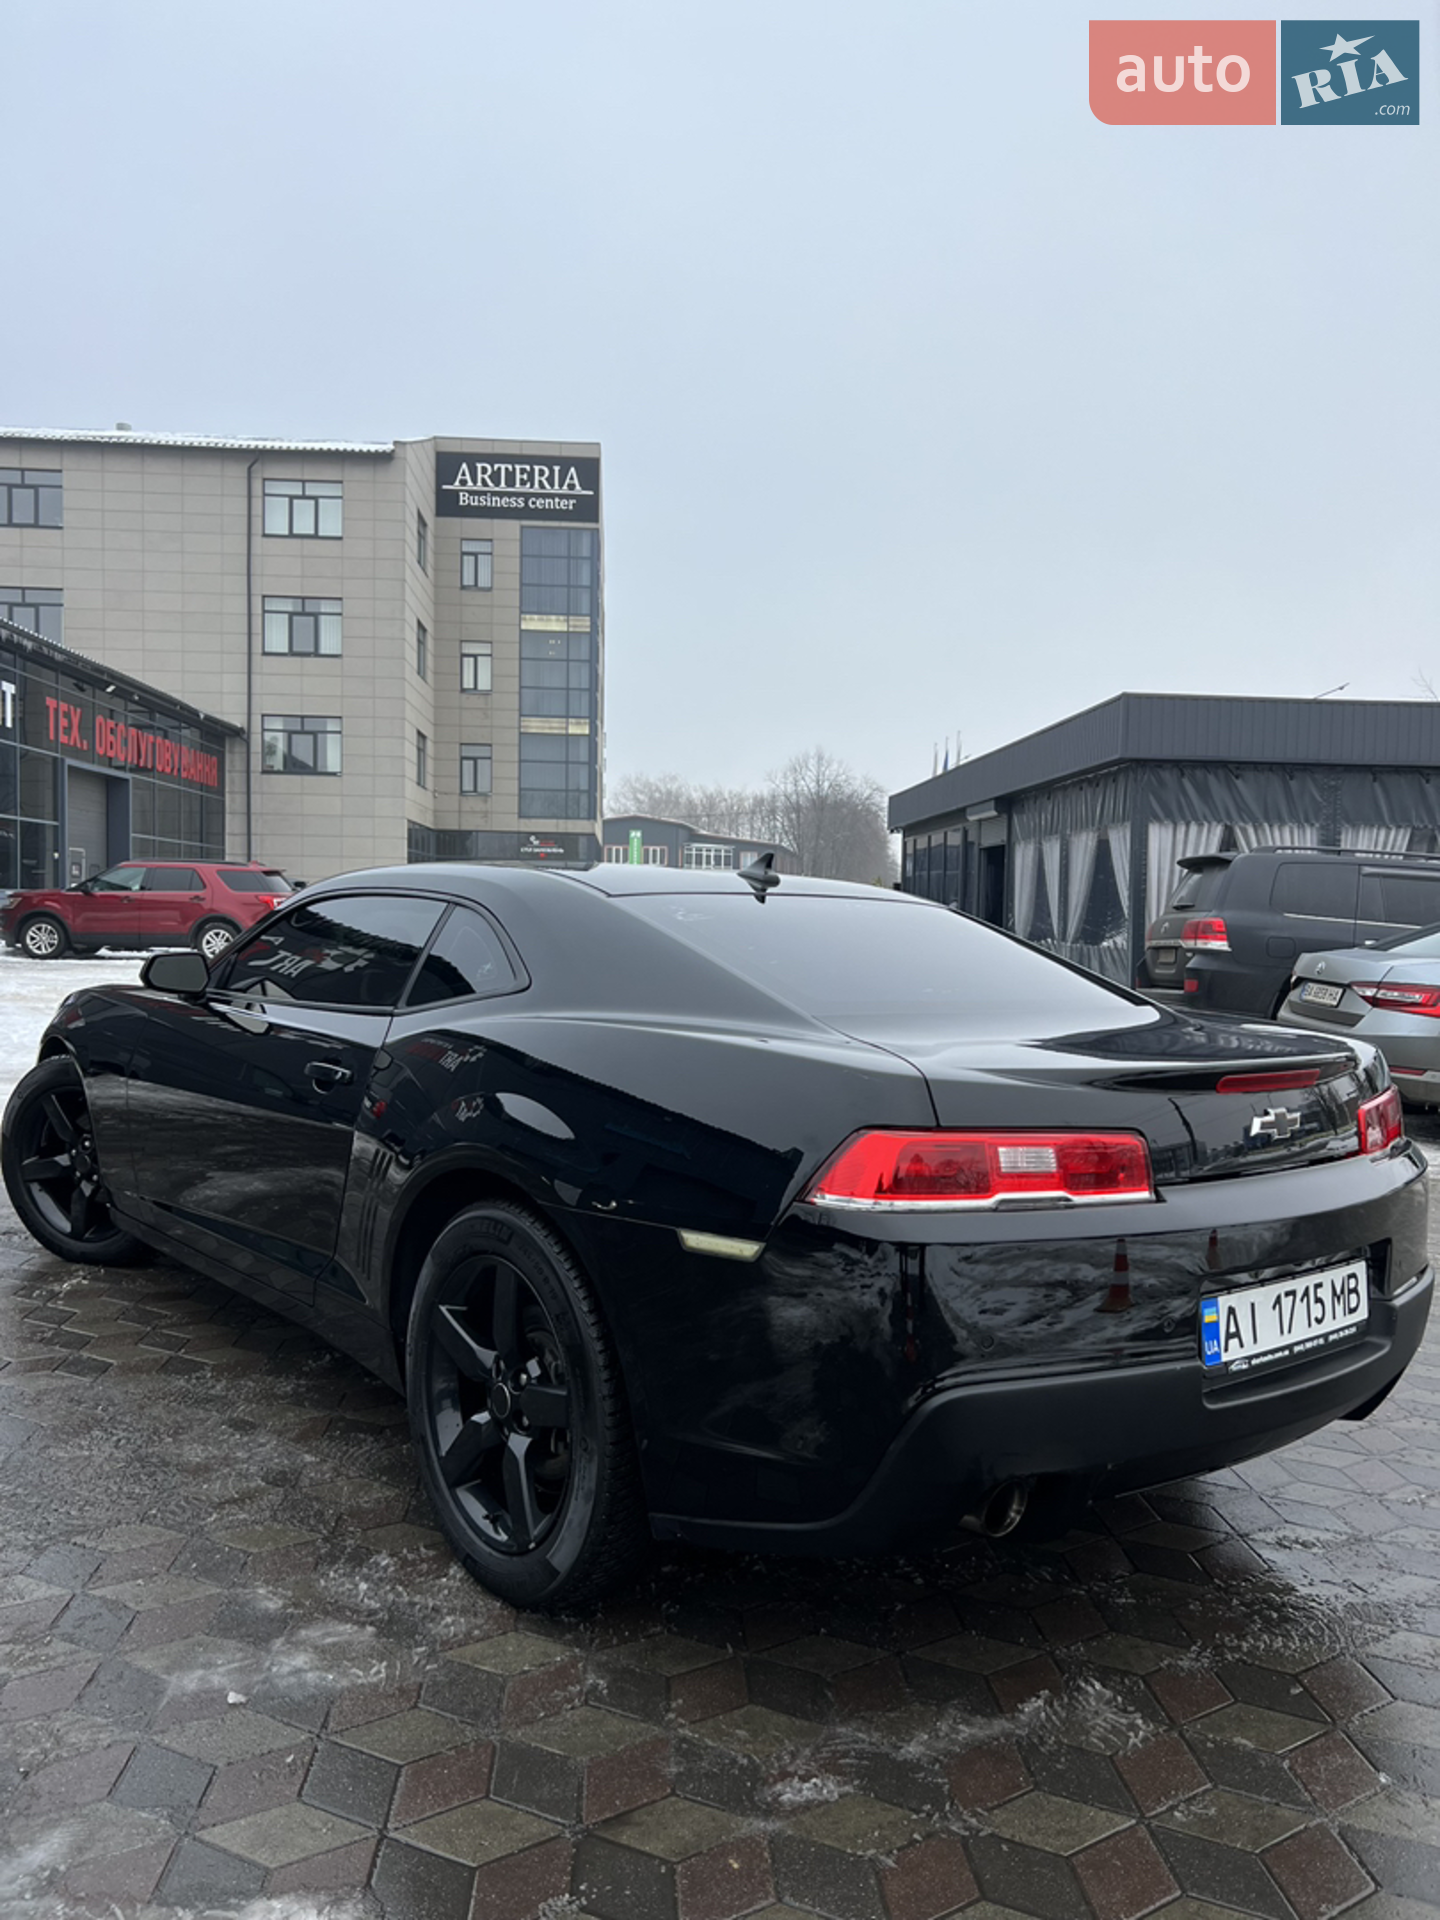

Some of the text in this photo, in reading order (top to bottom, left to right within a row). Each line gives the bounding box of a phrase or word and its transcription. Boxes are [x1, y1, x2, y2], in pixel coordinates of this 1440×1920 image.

[453, 462, 582, 491] ARTERIA
[459, 492, 577, 510] Business center
[46, 697, 218, 787] ТЕХ. ОБСЛУГОВУВАННЯ
[1224, 1272, 1361, 1353] AI 1715 MB
[1204, 1339, 1220, 1356] UA
